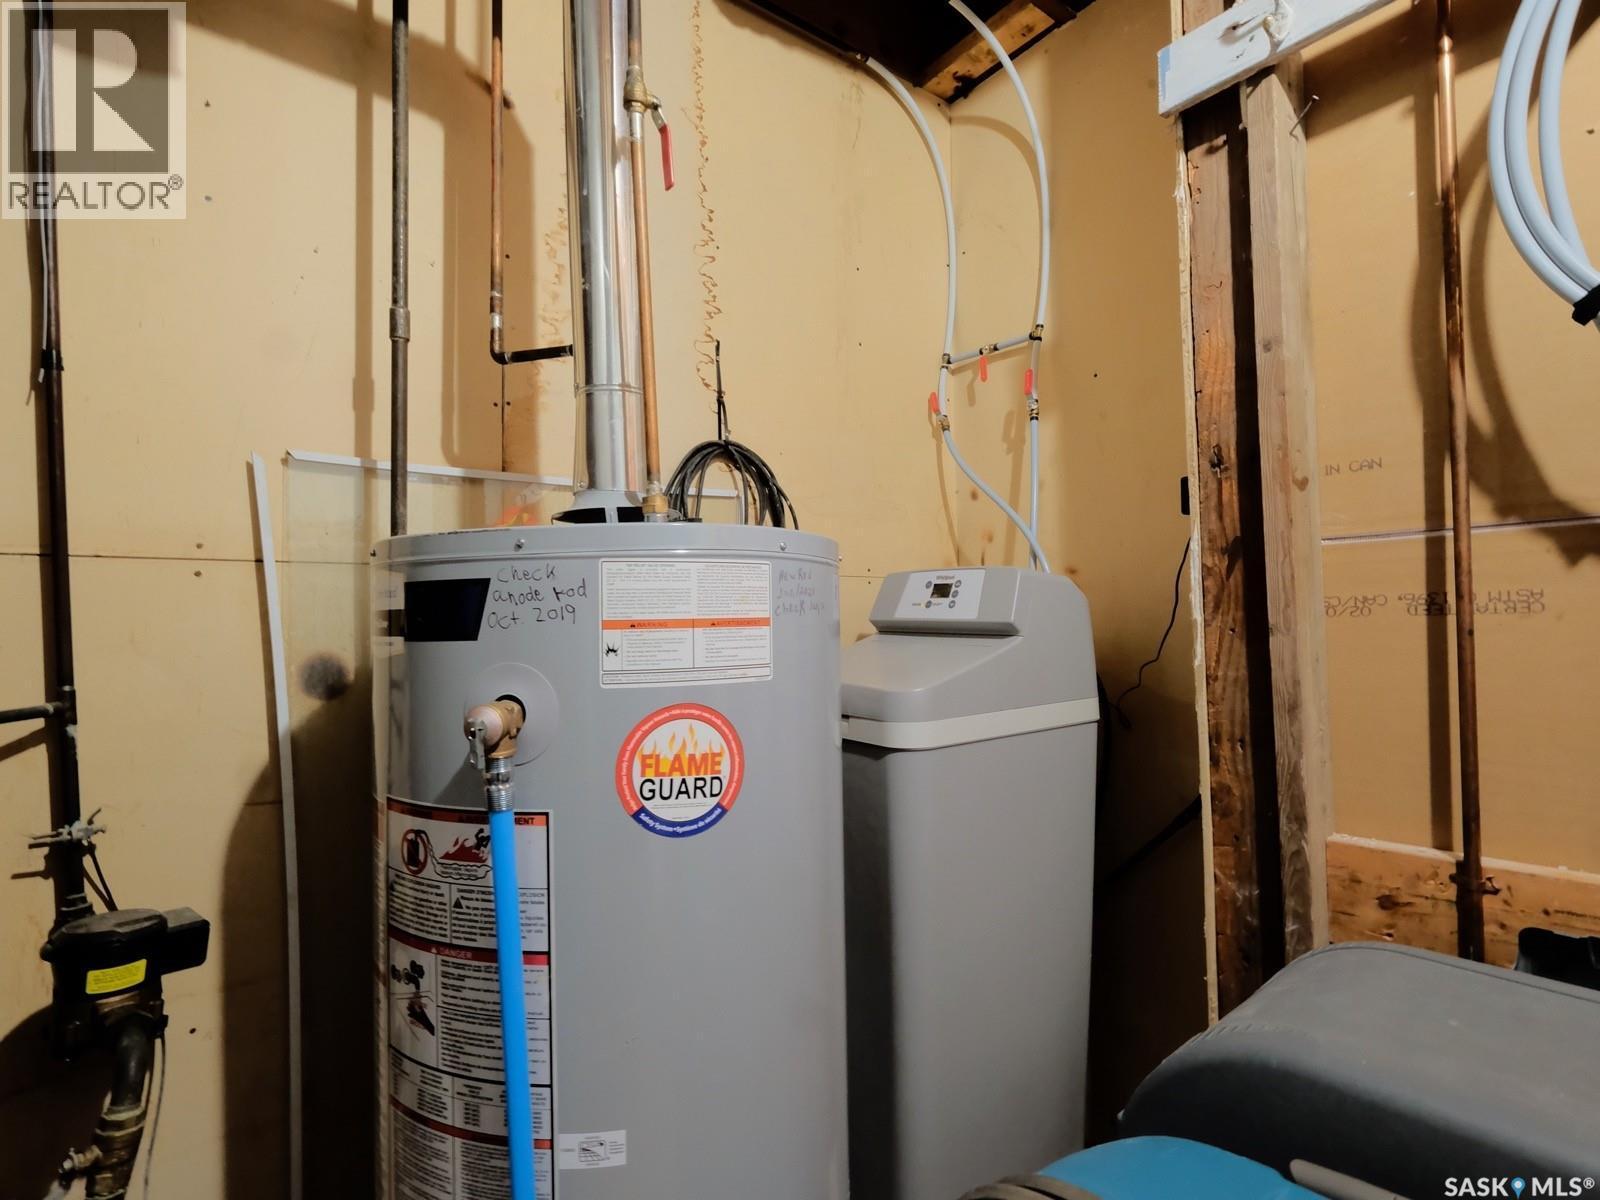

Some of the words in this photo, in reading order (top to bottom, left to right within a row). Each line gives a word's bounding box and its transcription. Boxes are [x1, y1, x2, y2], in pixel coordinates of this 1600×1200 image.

[1349, 456, 1382, 473] CAN
[493, 585, 544, 606] anode
[1487, 588, 1545, 604] ASTM
[533, 604, 576, 625] 2019
[640, 752, 722, 778] FLAME
[639, 776, 723, 801] GUARD
